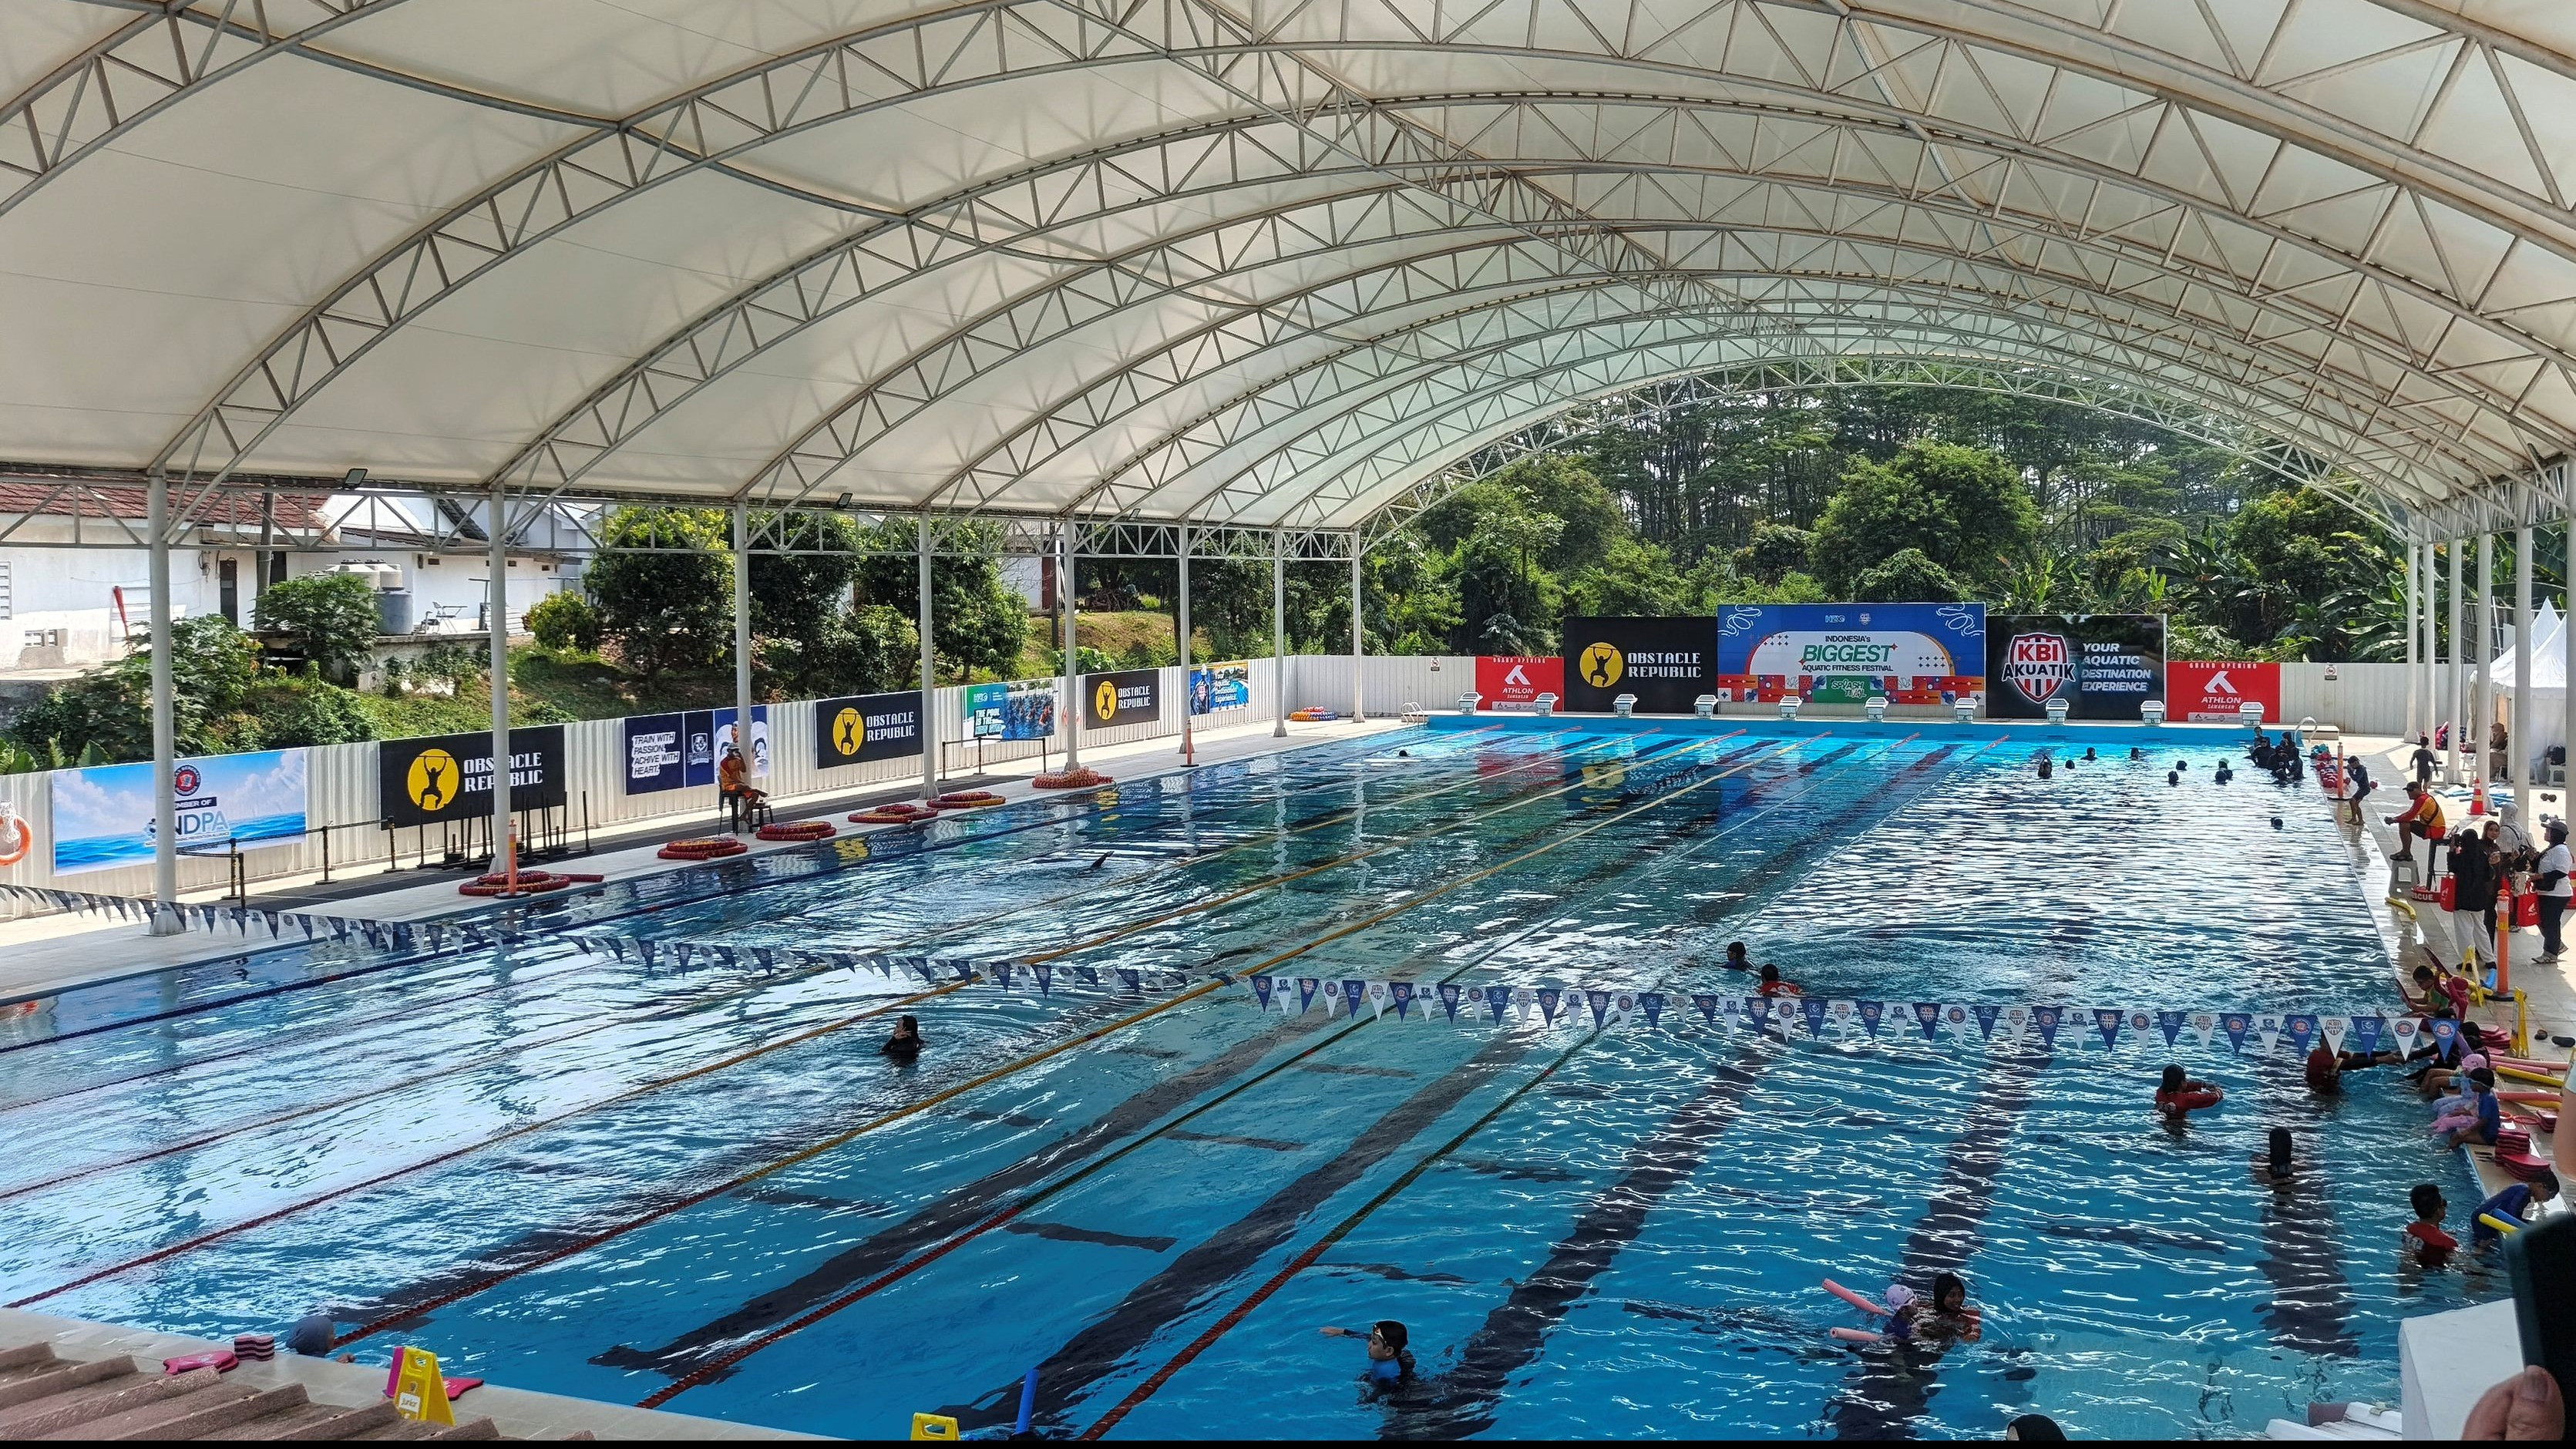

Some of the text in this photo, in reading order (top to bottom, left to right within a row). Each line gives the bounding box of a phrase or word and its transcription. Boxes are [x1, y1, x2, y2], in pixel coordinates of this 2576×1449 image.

[1803, 644, 1892, 662] BIGGEST
[2018, 644, 2058, 661] KBI
[2083, 643, 2120, 652] YOUR
[1627, 652, 1700, 664] OBSTACLE
[2083, 655, 2140, 665] AQUATIC
[1628, 666, 1702, 677] REPUBLIC
[1802, 664, 1831, 673] AQUATIC
[2003, 664, 2075, 681] AKUATIK
[2081, 669, 2151, 678] DESTINATION
[1118, 685, 1150, 698] OBSTACLE
[2081, 681, 2147, 691] EXPERIENCE
[1118, 697, 1151, 709] REPUBLIC
[866, 711, 914, 728] OBSTACLE
[634, 733, 674, 745] TRAIN WITH
[866, 725, 915, 741] REPUBLIC
[464, 752, 542, 774] OBSACLE
[634, 753, 679, 765] ACHIVE WITH
[465, 770, 543, 792] REPBLIC
